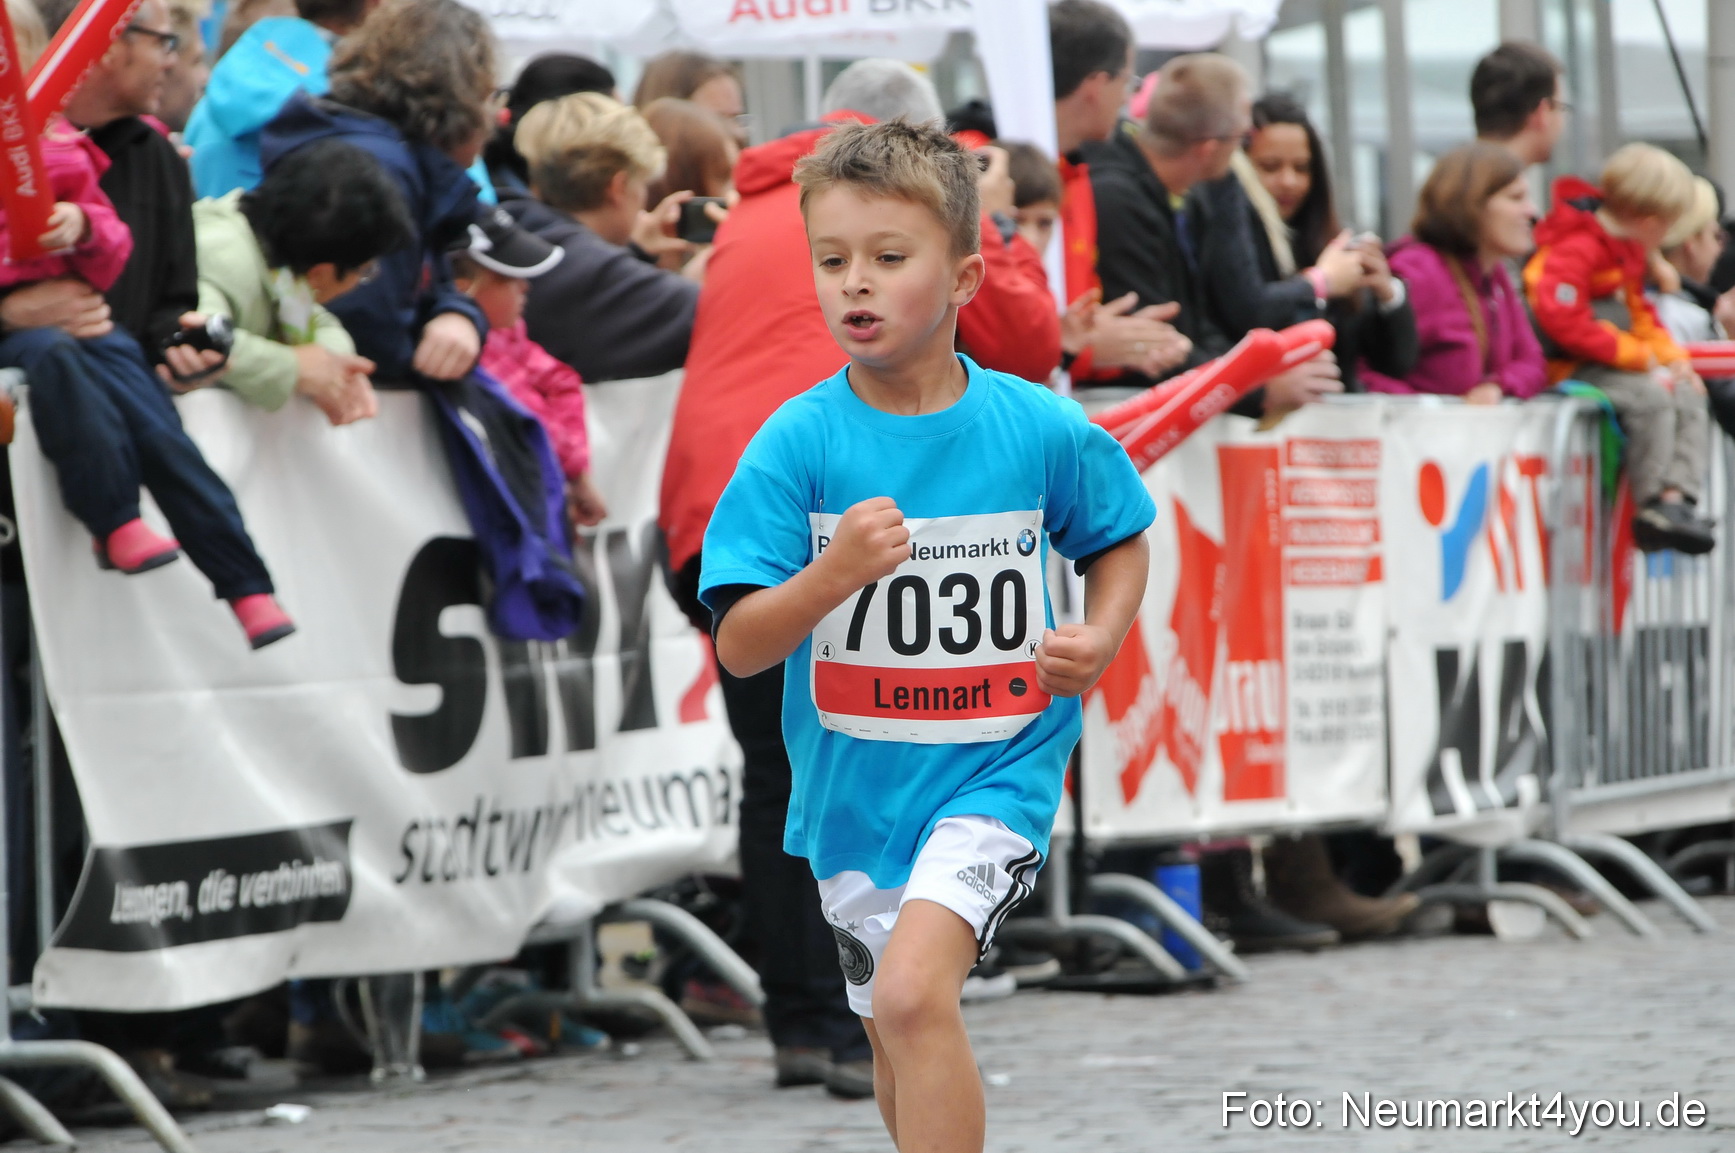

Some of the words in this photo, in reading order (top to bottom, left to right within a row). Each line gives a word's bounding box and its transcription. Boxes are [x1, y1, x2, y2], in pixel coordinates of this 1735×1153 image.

[8, 145, 37, 197] Audi
[910, 537, 1010, 562] Neumarkt
[845, 569, 1028, 656] 7030
[874, 678, 992, 711] Lennart
[198, 868, 238, 914] die
[956, 869, 998, 906] adidas
